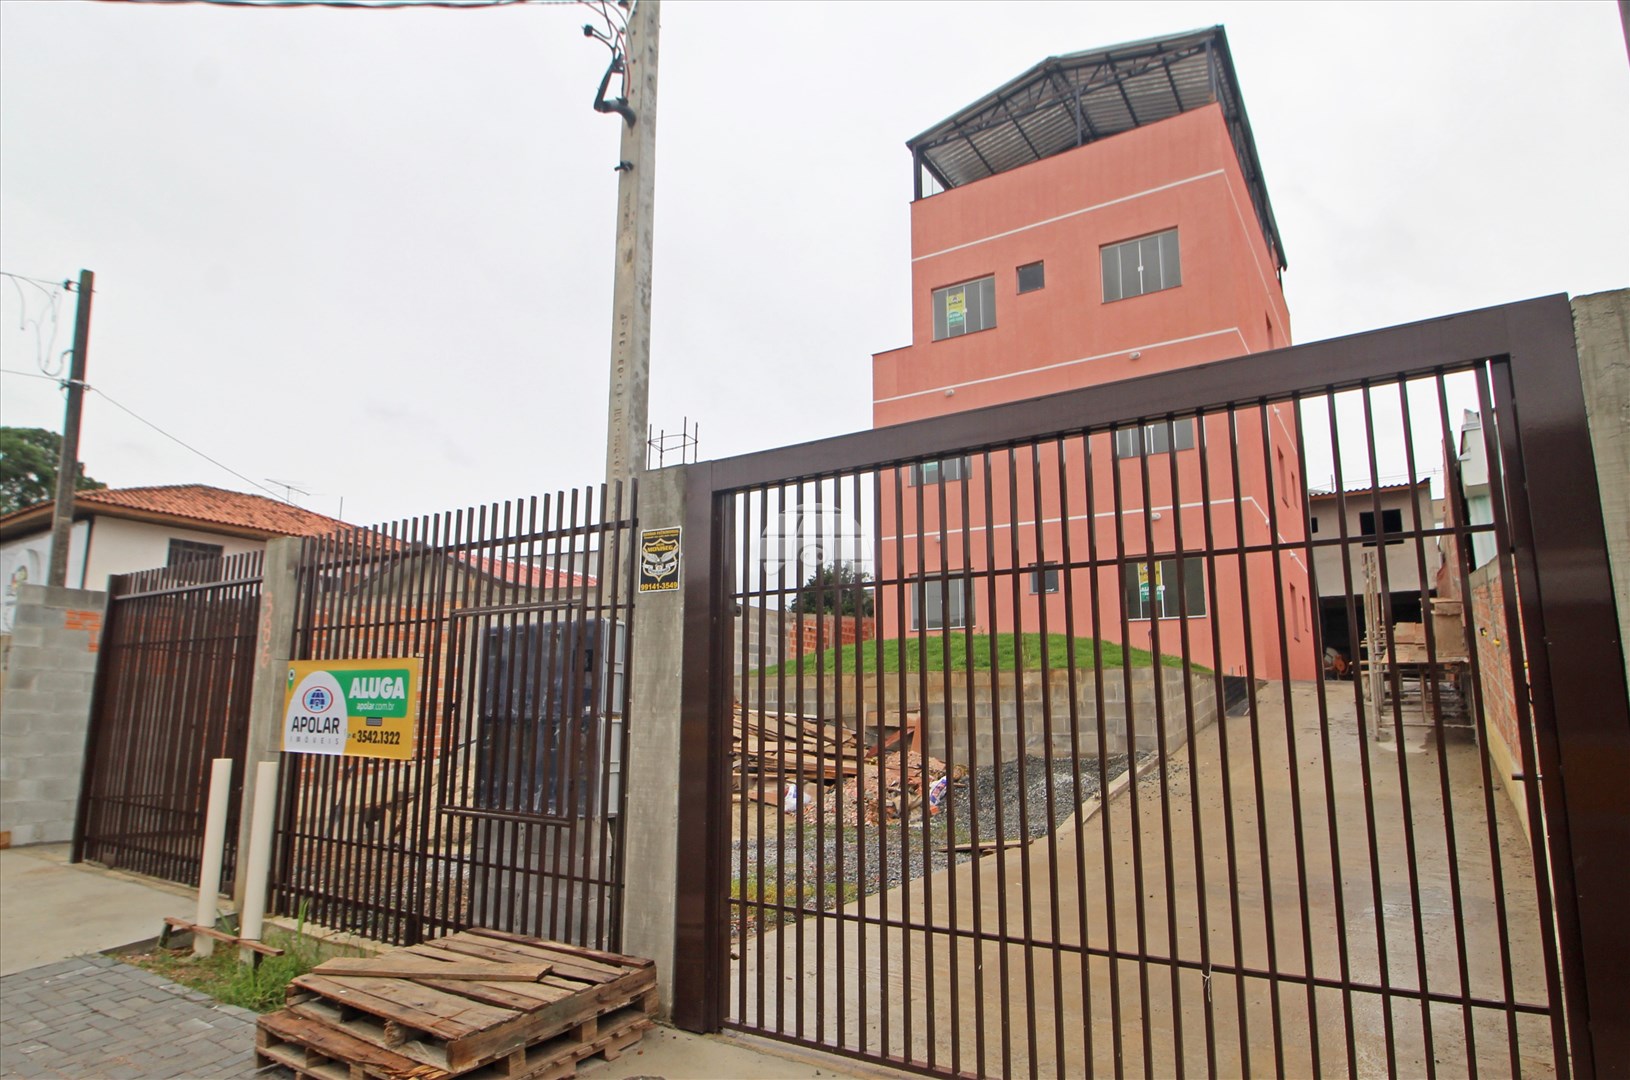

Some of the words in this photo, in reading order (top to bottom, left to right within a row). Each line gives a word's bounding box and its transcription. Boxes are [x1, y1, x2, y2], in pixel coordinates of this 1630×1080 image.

[640, 582, 678, 590] 99141-3549
[349, 677, 405, 699] ALUGA
[356, 701, 395, 712] apolar.com.br
[291, 716, 340, 734] APOLAR
[356, 730, 401, 745] 3542.1322
